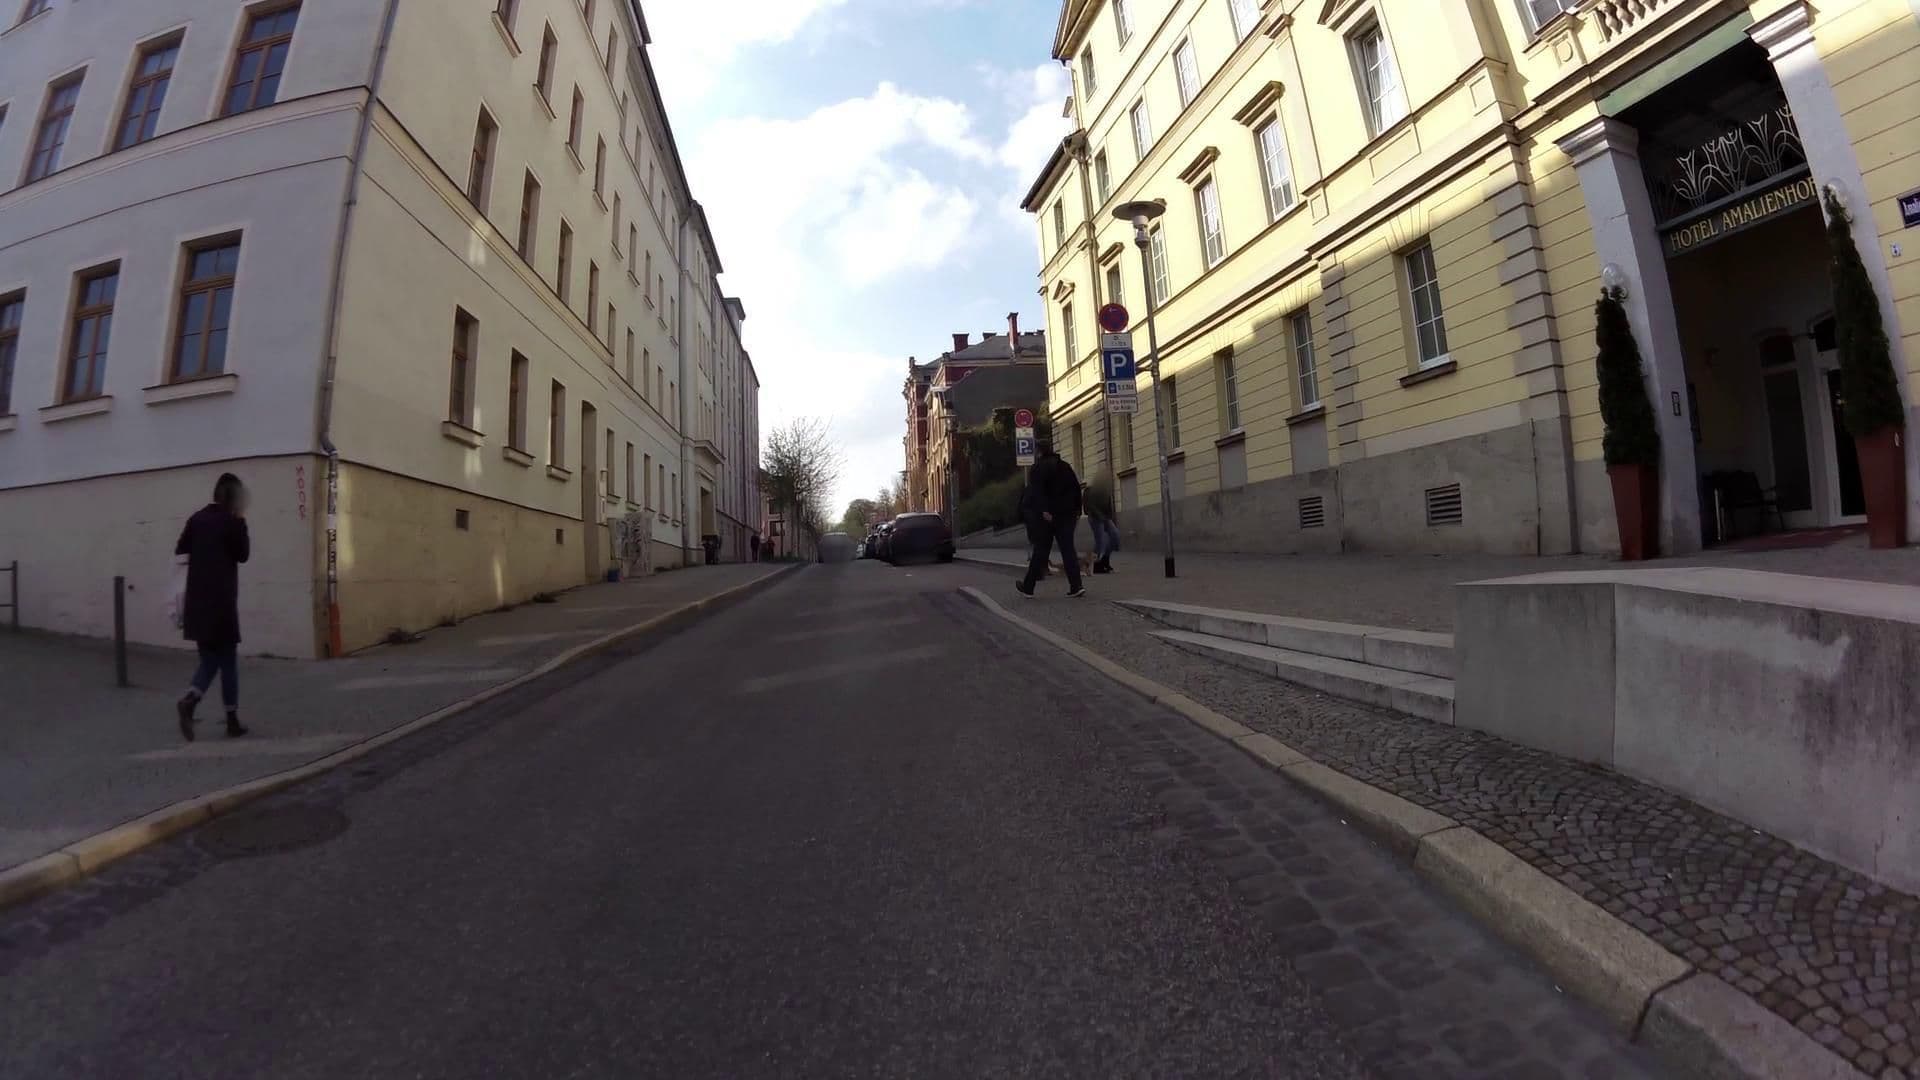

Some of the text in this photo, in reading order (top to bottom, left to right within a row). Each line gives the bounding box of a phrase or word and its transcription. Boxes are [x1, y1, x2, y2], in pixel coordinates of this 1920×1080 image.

[1670, 219, 1719, 251] HOTEL
[1110, 353, 1127, 377] P
[1019, 439, 1029, 454] P
